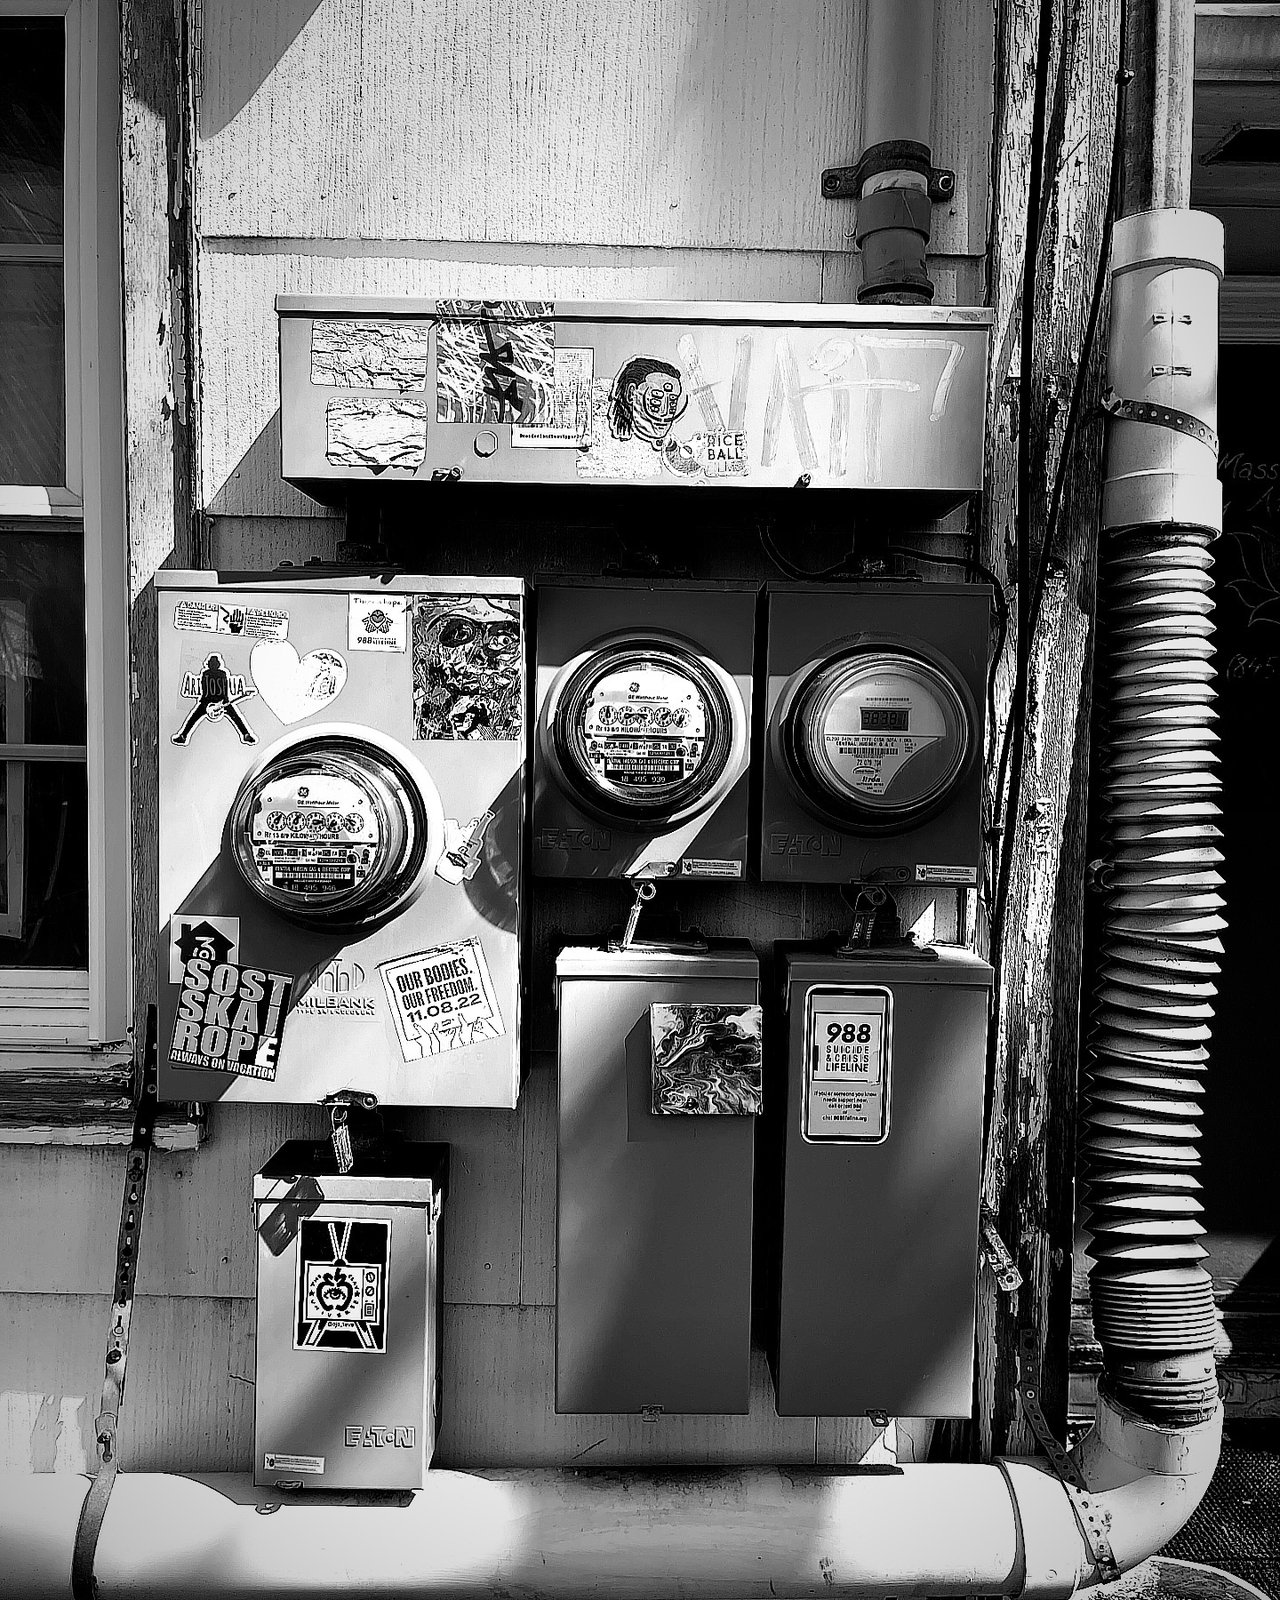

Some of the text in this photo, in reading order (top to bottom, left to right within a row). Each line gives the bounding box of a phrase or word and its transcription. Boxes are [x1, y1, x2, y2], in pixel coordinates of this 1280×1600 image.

[707, 434, 744, 447] RICE
[707, 448, 743, 460] BALL
[183, 675, 201, 696] ARI
[396, 957, 474, 993] OUR BODIES.
[296, 995, 375, 1010] MILBANK
[402, 976, 478, 1010] OUR FREEDOM.
[407, 993, 482, 1023] 11.08.22
[172, 1018, 278, 1068] ROPE
[826, 1022, 872, 1044] 988
[826, 1045, 869, 1054] SUICIDE
[826, 1054, 869, 1063] & CRISIS
[170, 1049, 276, 1080] ALWAYS ON VACATION
[825, 1063, 869, 1073] LIFELINE
[344, 1425, 415, 1448] EATON
